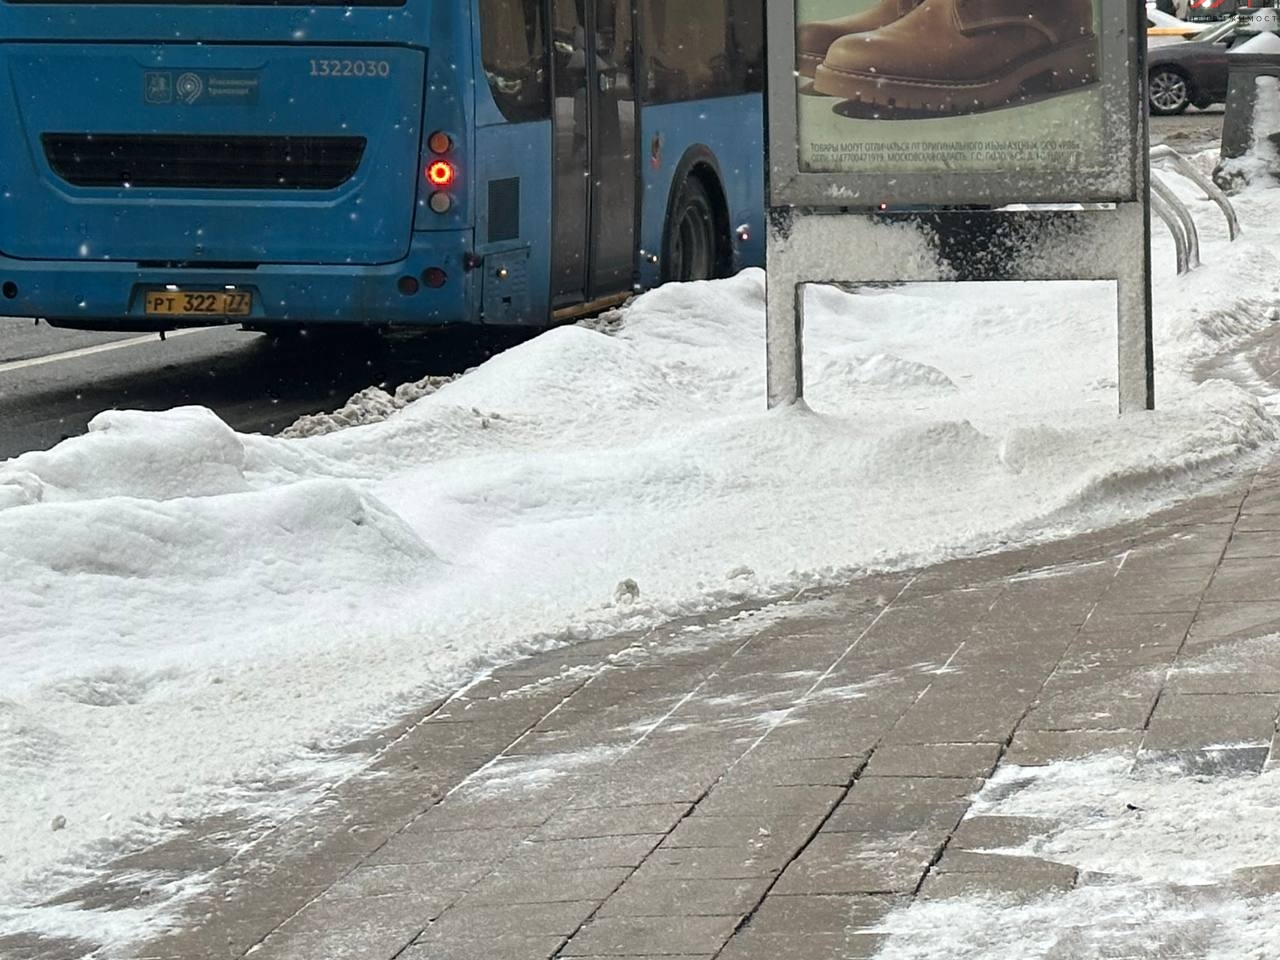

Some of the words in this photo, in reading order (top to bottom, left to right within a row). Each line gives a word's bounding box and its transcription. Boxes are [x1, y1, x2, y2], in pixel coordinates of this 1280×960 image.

[309, 59, 390, 76] 1322030
[183, 294, 217, 312] 322
[226, 293, 245, 308] 77
